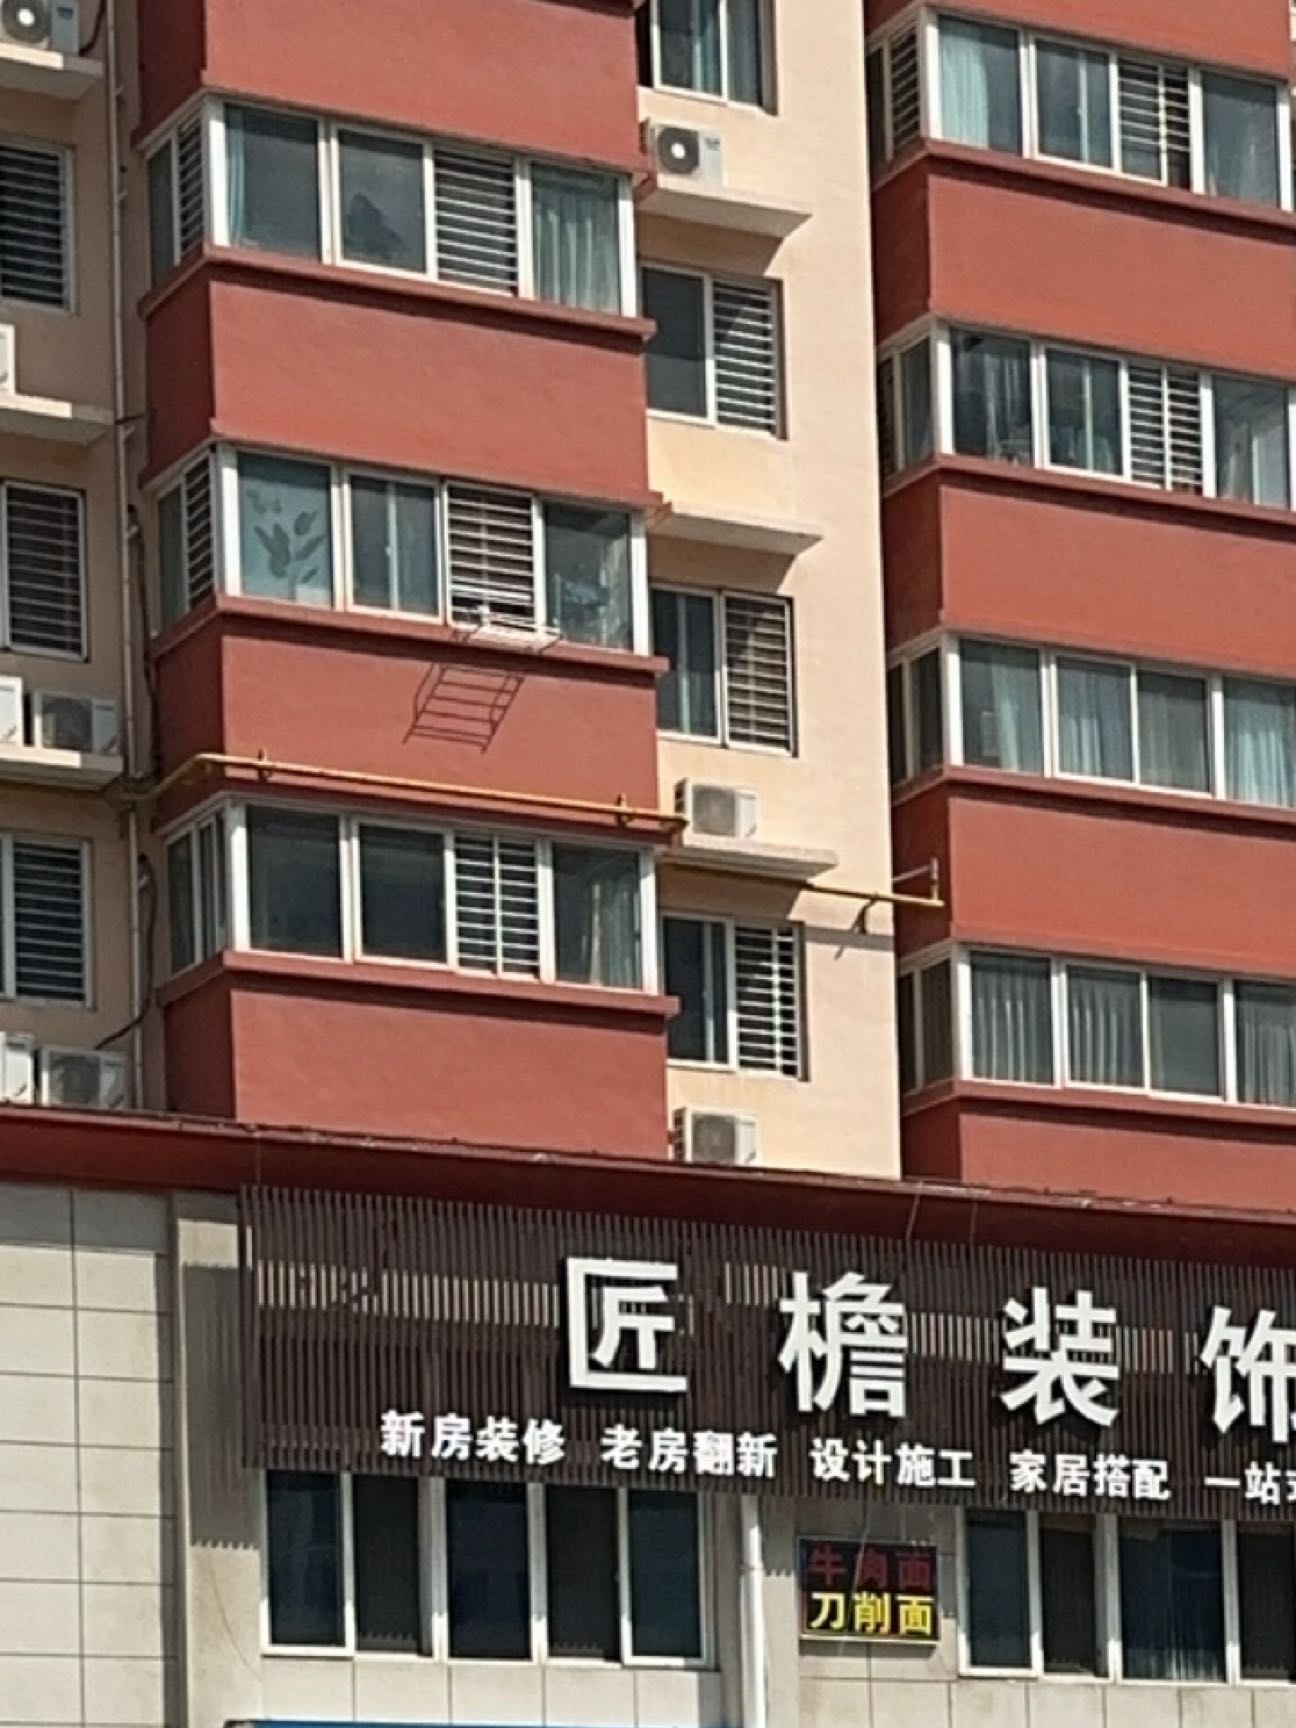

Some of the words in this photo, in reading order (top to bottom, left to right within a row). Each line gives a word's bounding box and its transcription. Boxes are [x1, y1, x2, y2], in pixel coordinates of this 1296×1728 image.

[380, 1409, 564, 1465] 新房装修
[602, 1424, 778, 1478] 老房翻新
[809, 1436, 976, 1488] 设计施工
[1009, 1448, 1171, 1501] 家居搭配
[810, 1591, 935, 1635] 刀削面
